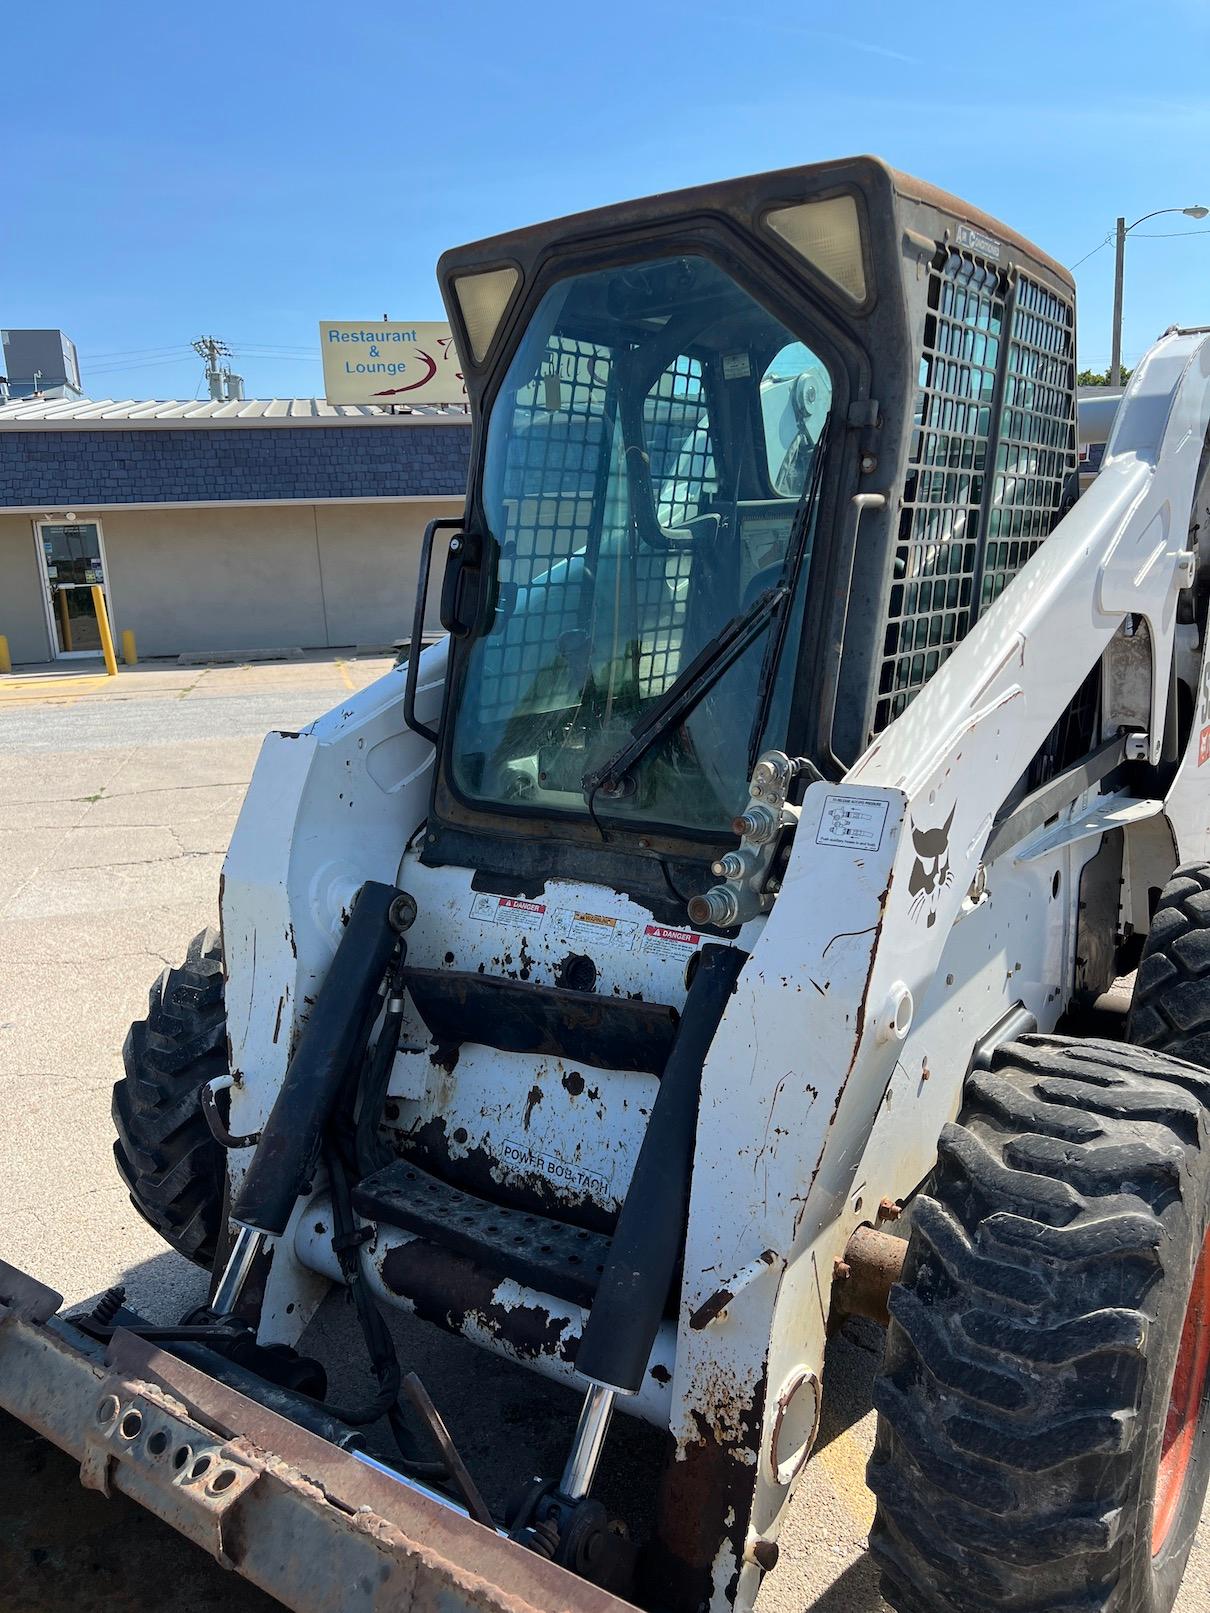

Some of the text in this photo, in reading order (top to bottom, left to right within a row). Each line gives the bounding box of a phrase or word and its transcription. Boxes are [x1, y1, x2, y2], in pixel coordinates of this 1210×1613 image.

[328, 329, 417, 343] Restaurant
[369, 345, 380, 358] &
[345, 361, 406, 376] Lounge
[512, 900, 540, 912] DANGER
[662, 929, 692, 941] DANGER
[503, 1145, 545, 1170] POWER
